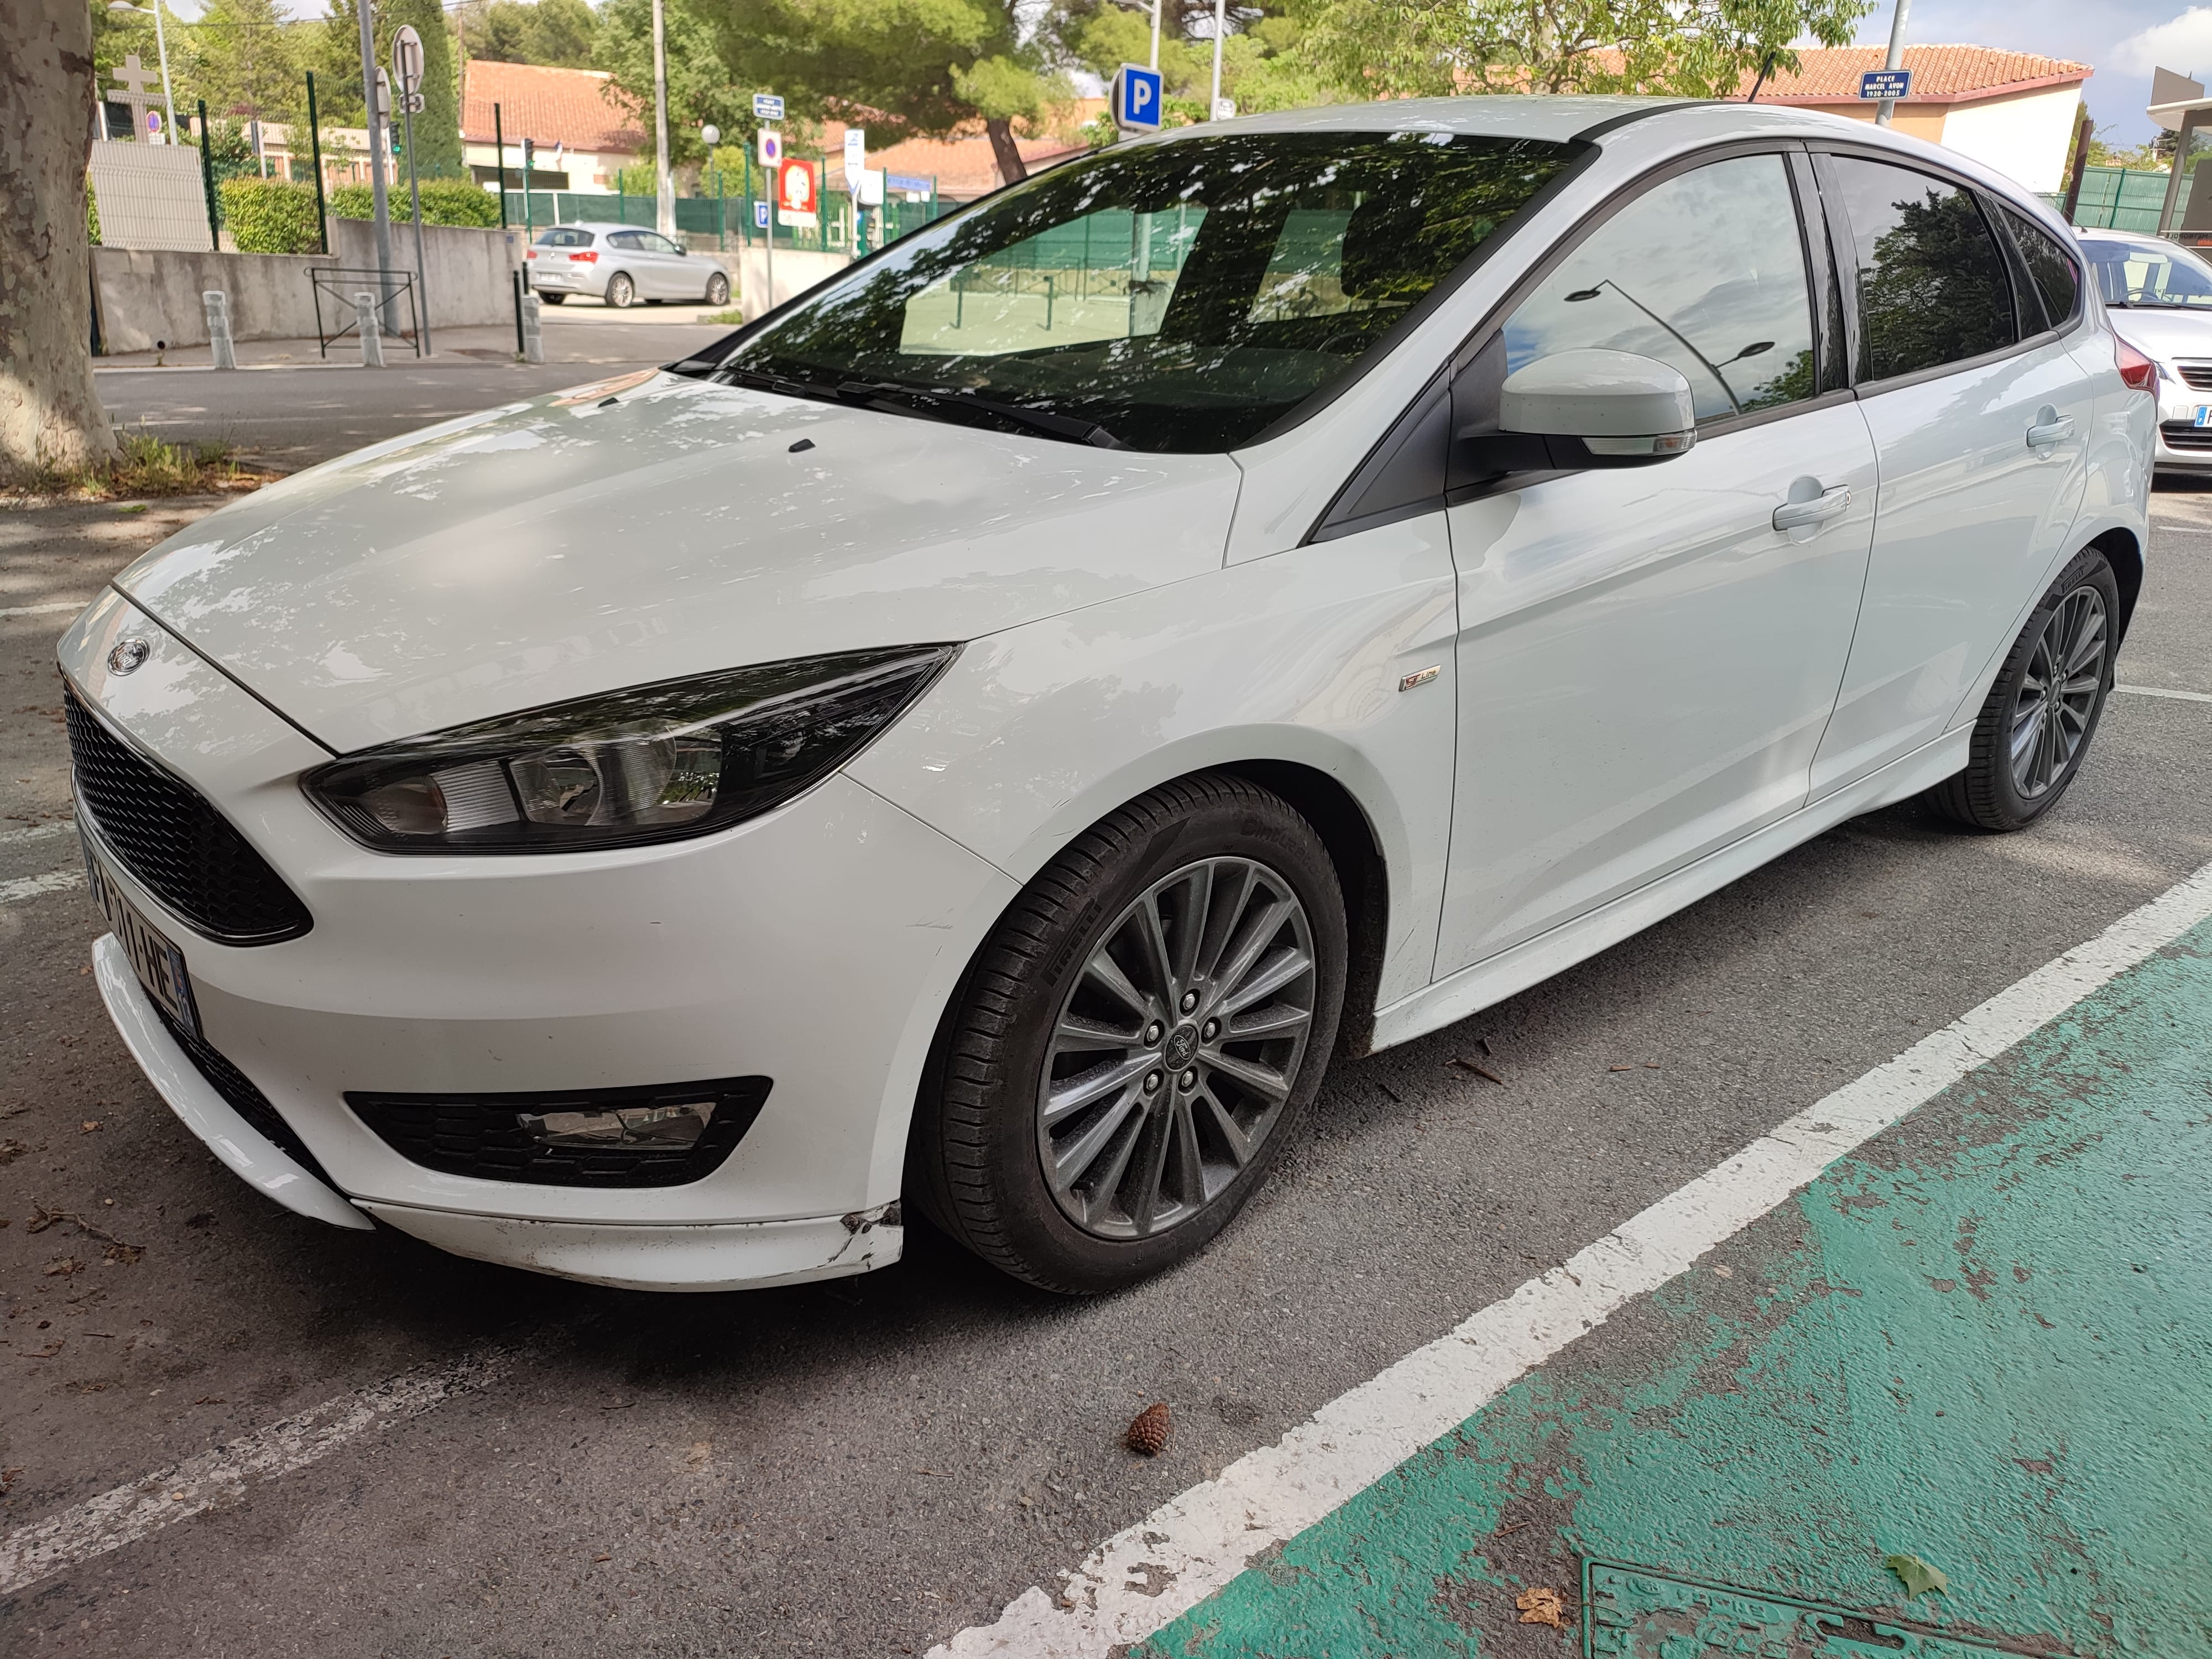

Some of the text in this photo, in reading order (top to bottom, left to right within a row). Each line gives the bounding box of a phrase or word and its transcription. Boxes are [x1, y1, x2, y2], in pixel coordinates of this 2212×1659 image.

[1133, 78, 1152, 115] P
[1866, 89, 1900, 97] 1930-2005
[760, 207, 768, 223] P
[1421, 669, 1437, 680] Line
[1040, 898, 1103, 988] PIRELLI
[1176, 1039, 1190, 1057] Ford
